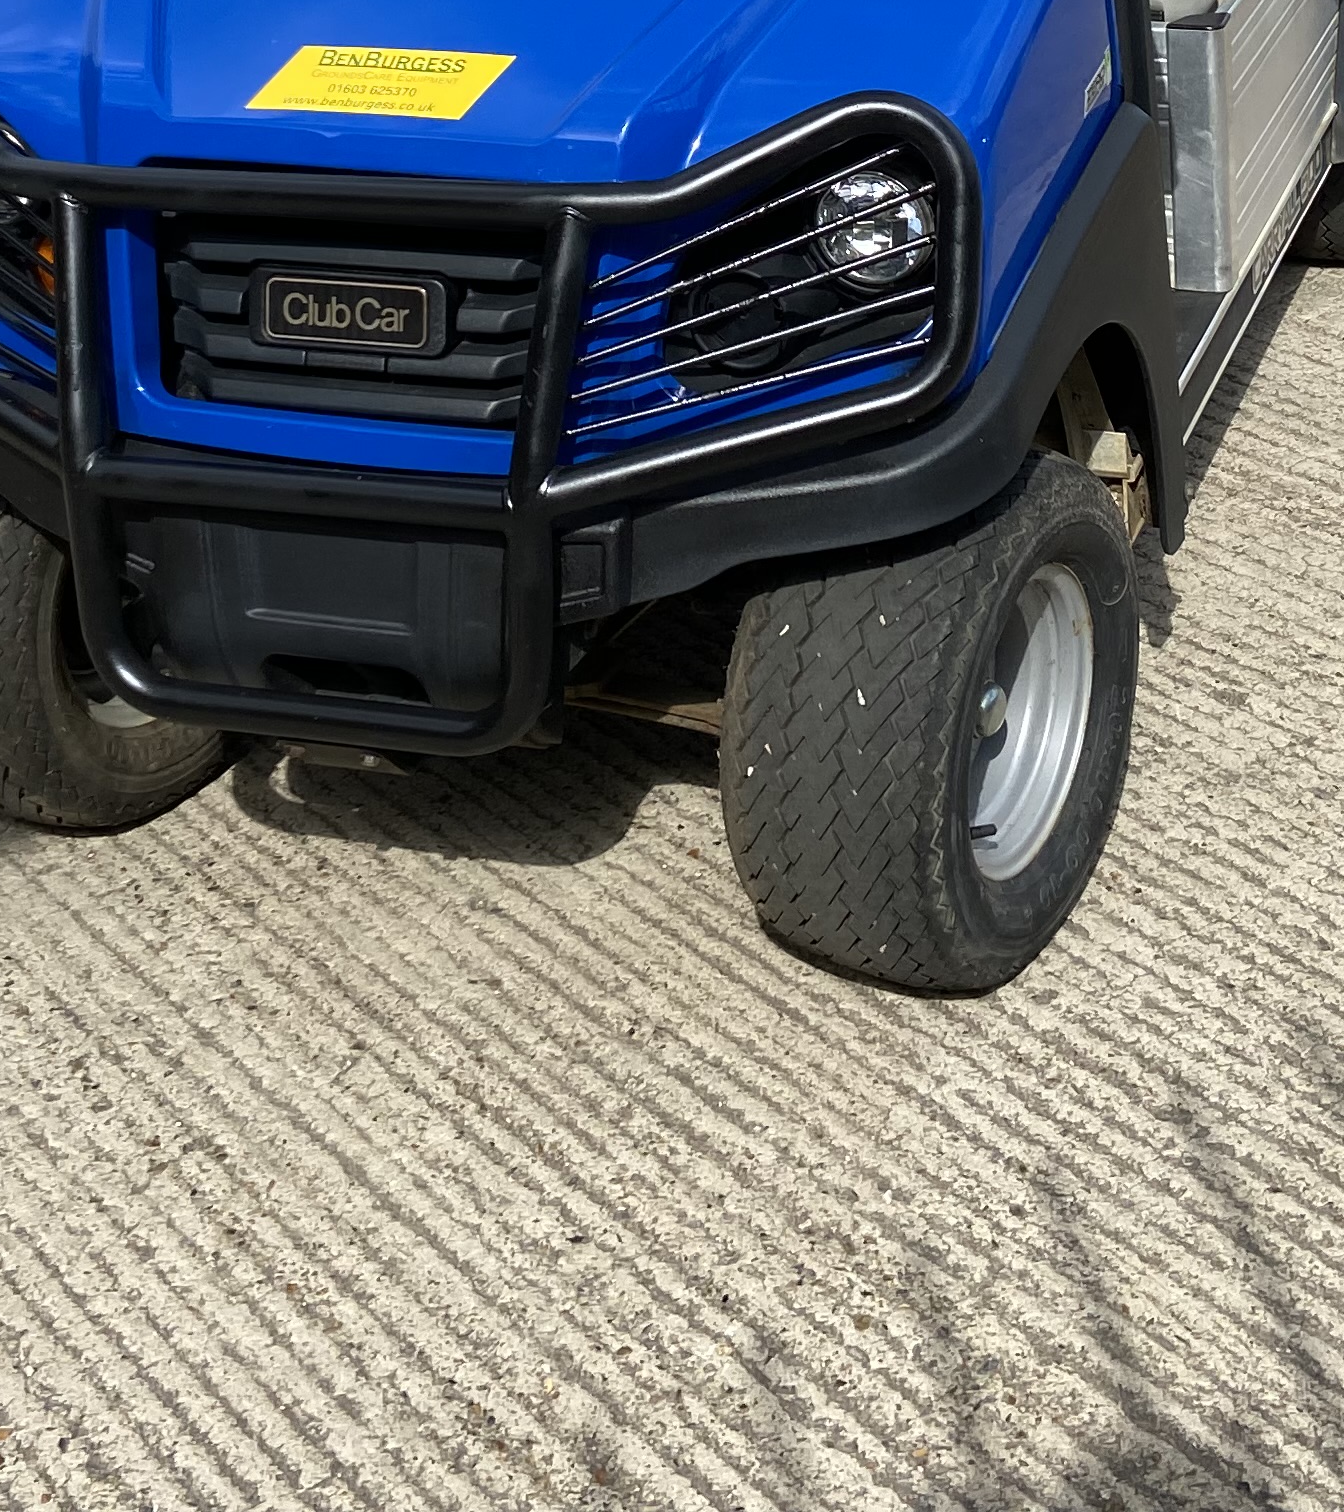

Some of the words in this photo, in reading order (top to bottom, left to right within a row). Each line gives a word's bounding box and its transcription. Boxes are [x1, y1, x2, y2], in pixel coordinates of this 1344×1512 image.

[327, 83, 367, 95] 01603
[369, 85, 417, 97] 625370
[282, 95, 436, 114] www.benburgess.co.uk
[283, 292, 351, 329] Club
[355, 297, 410, 332] Car
